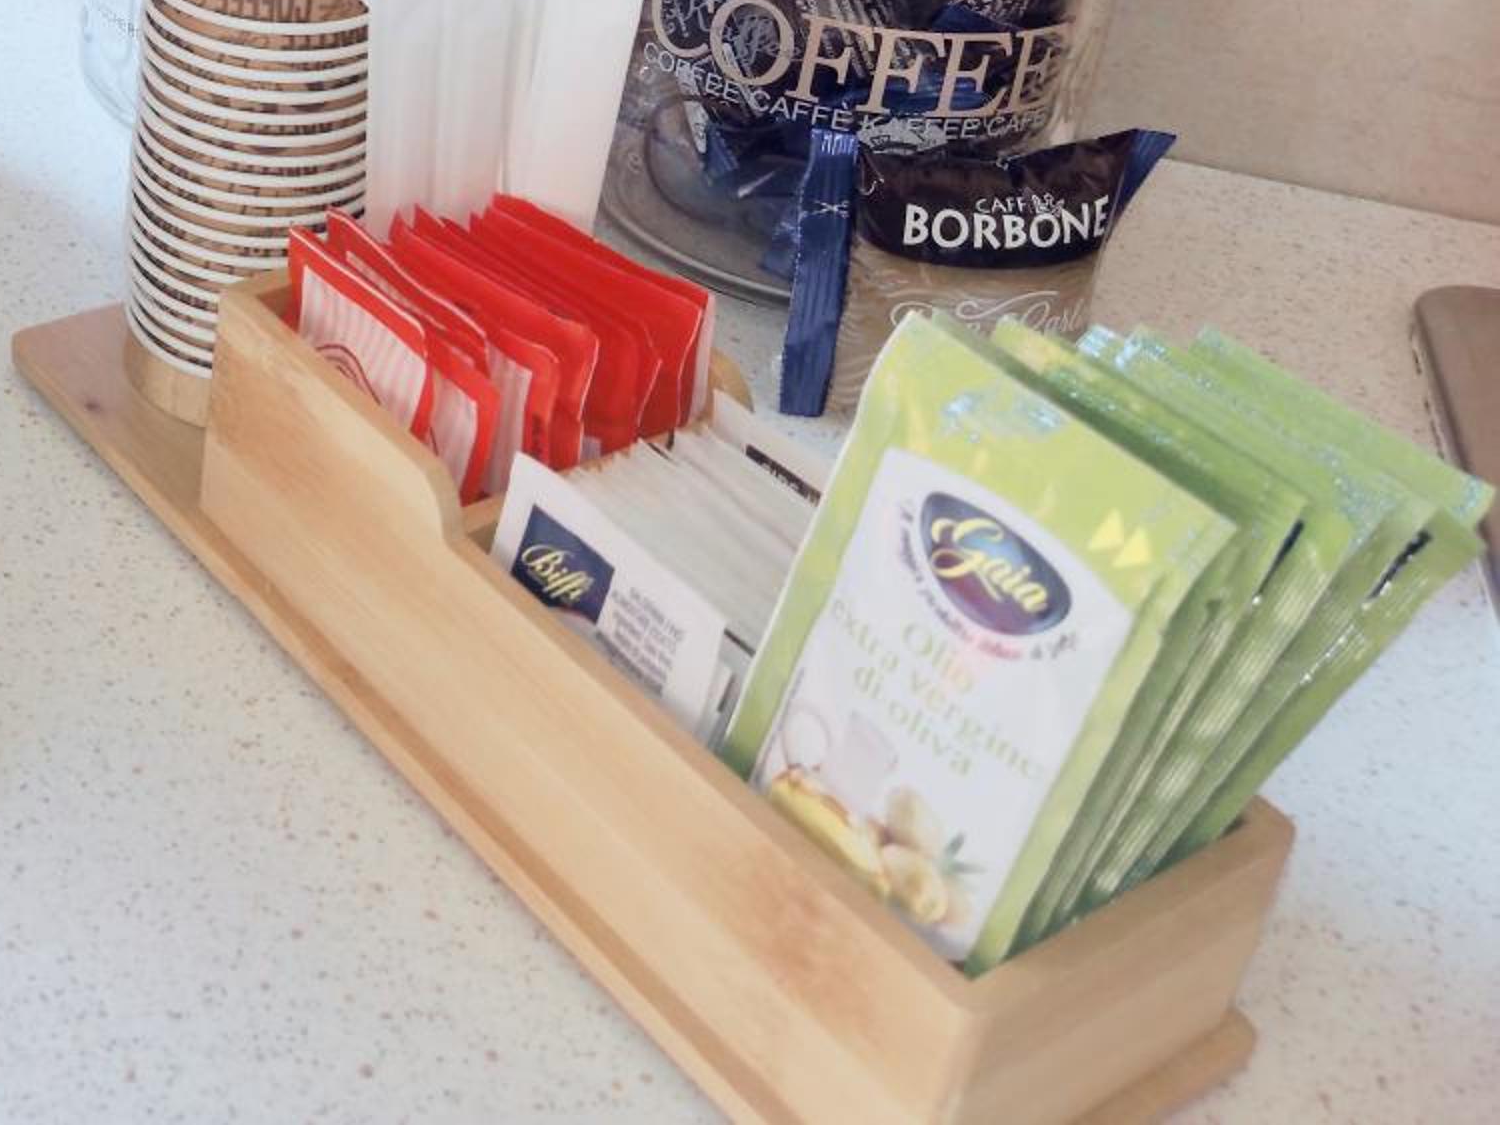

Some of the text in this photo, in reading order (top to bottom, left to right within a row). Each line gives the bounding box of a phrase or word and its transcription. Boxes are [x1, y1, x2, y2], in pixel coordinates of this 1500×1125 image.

[749, 89, 852, 132] CAFFÈ
[903, 194, 1109, 250] BORBONE
[834, 597, 900, 673] extra
[902, 621, 974, 695] Olio
[887, 700, 972, 777] oliva
